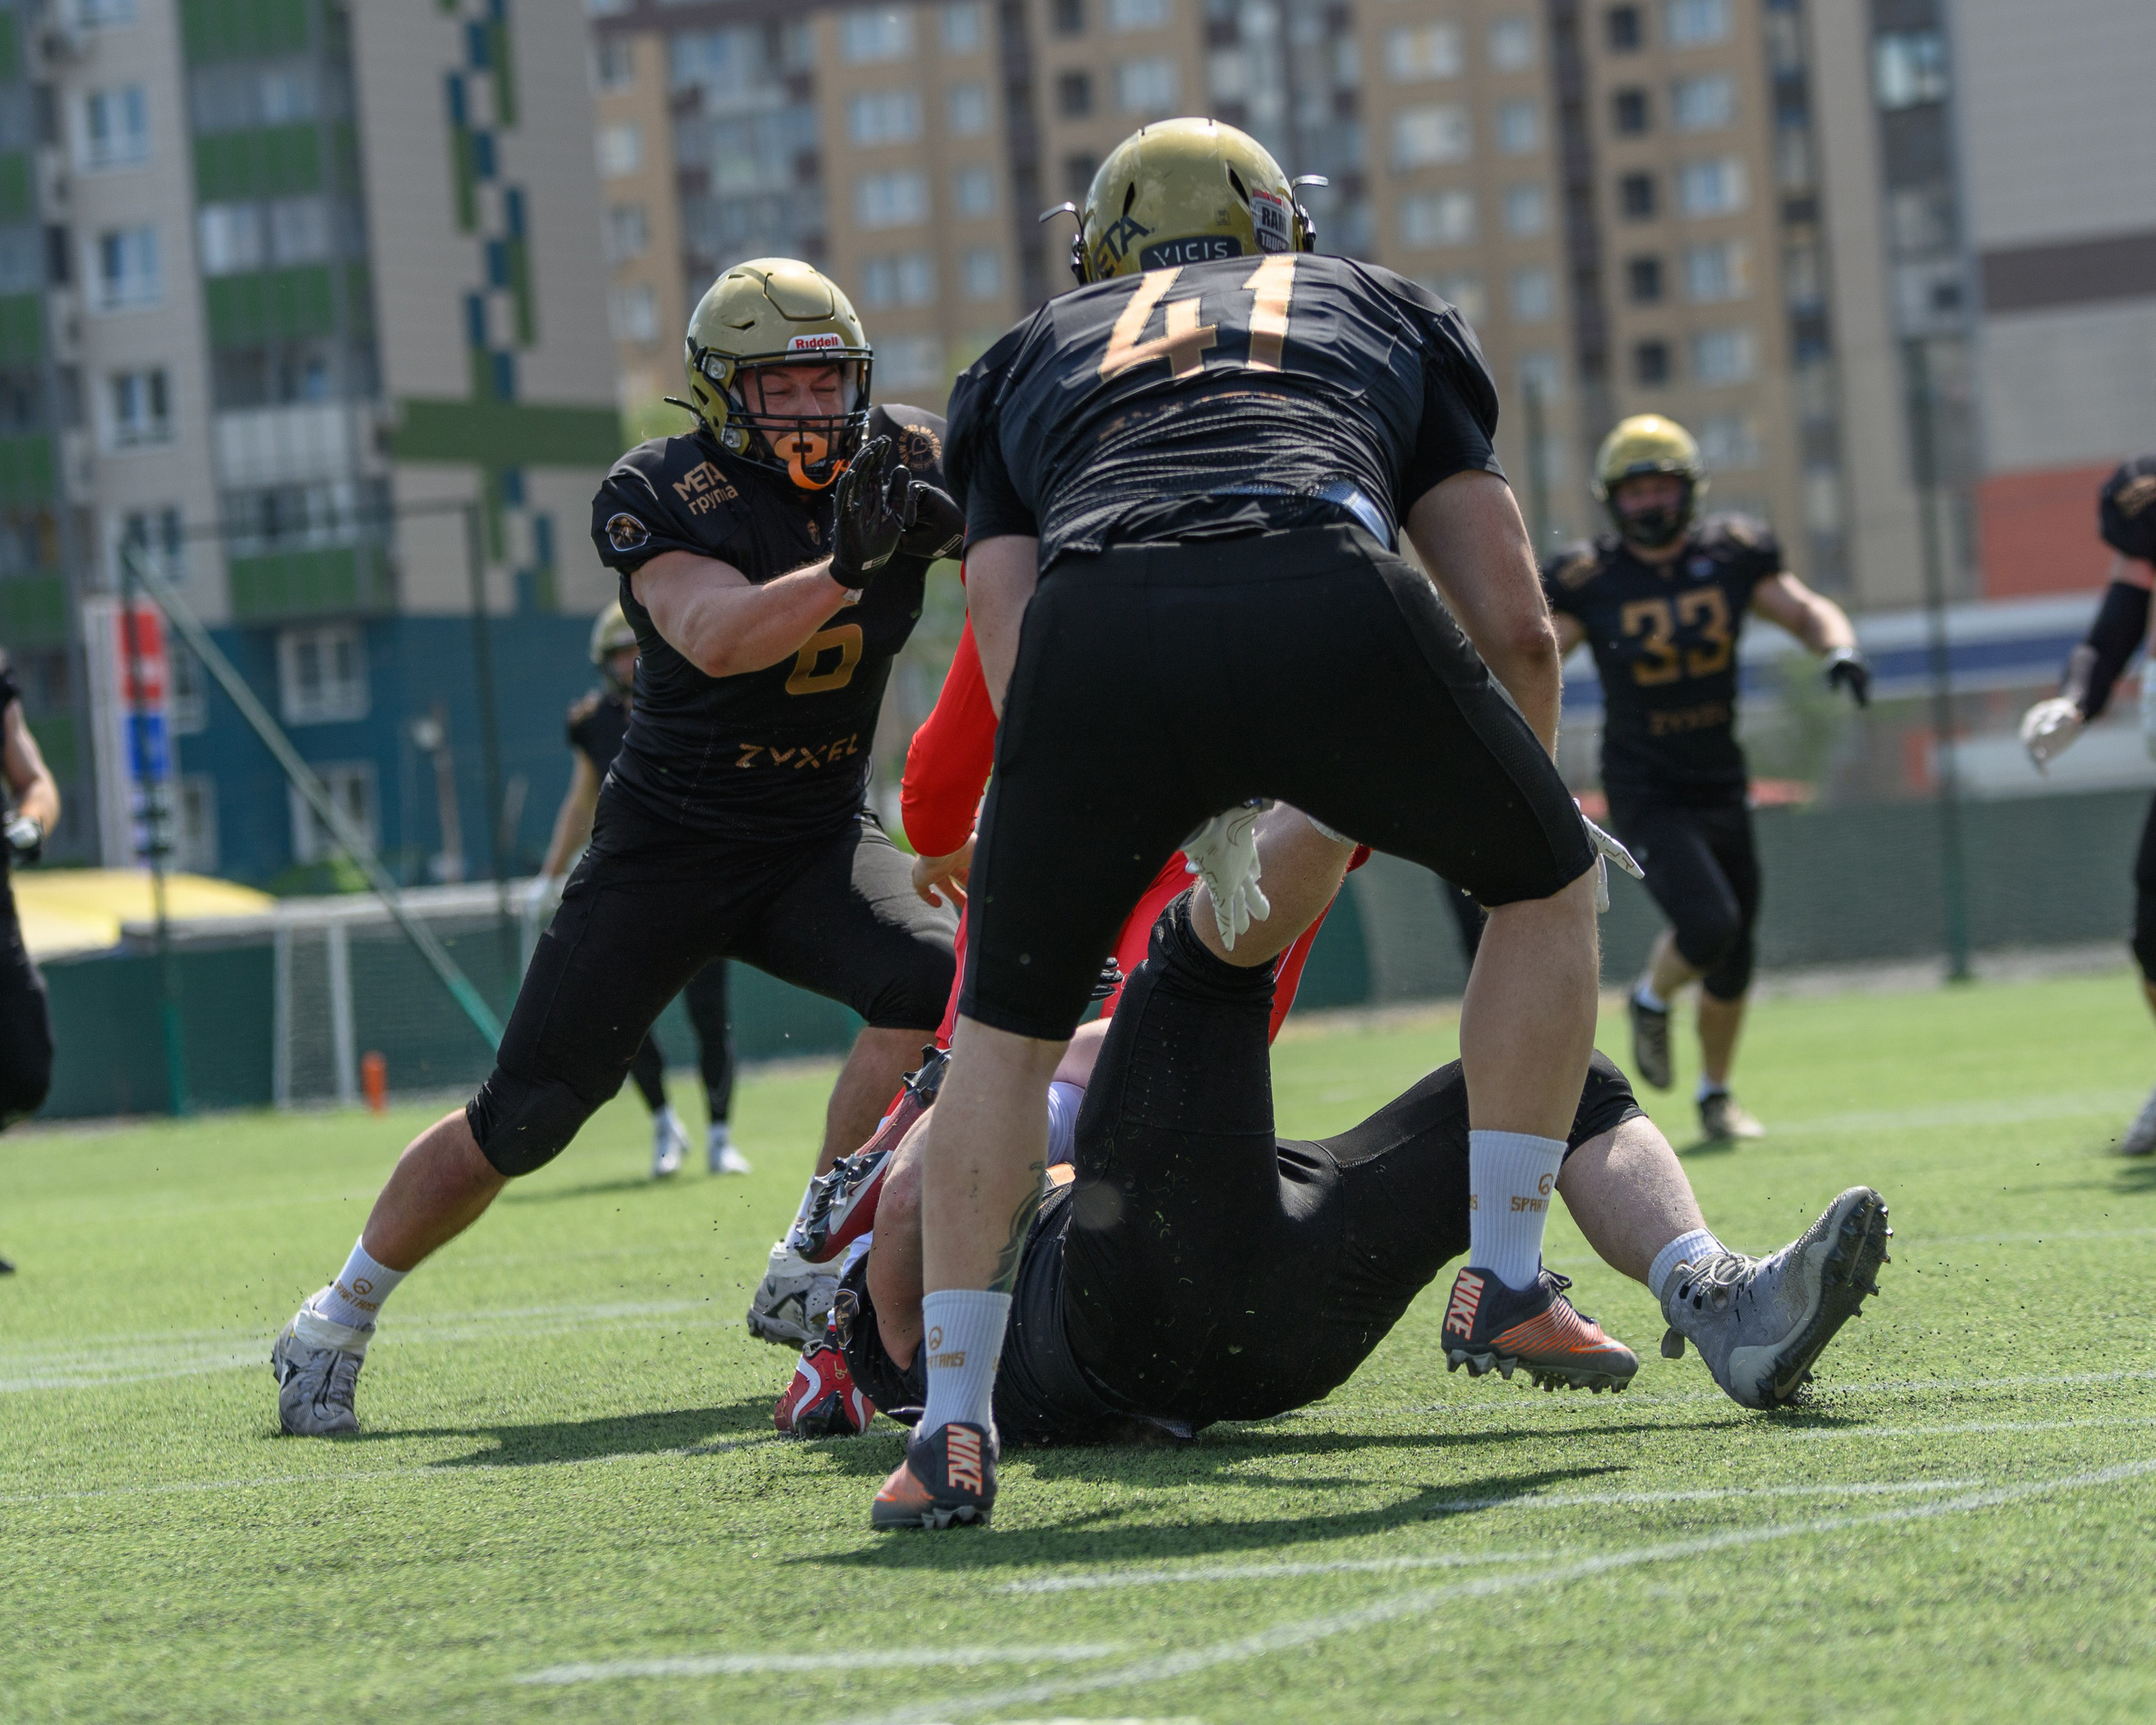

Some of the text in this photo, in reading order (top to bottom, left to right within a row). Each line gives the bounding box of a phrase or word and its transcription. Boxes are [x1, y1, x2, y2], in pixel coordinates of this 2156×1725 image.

[1153, 241, 1228, 267] VICIS
[1262, 206, 1288, 237] RAM
[795, 336, 839, 349] Riddell
[1099, 254, 1298, 384] 41
[1621, 587, 1731, 686] 33
[1446, 1269, 1485, 1341] NIKE
[947, 1423, 983, 1497] NIKE
